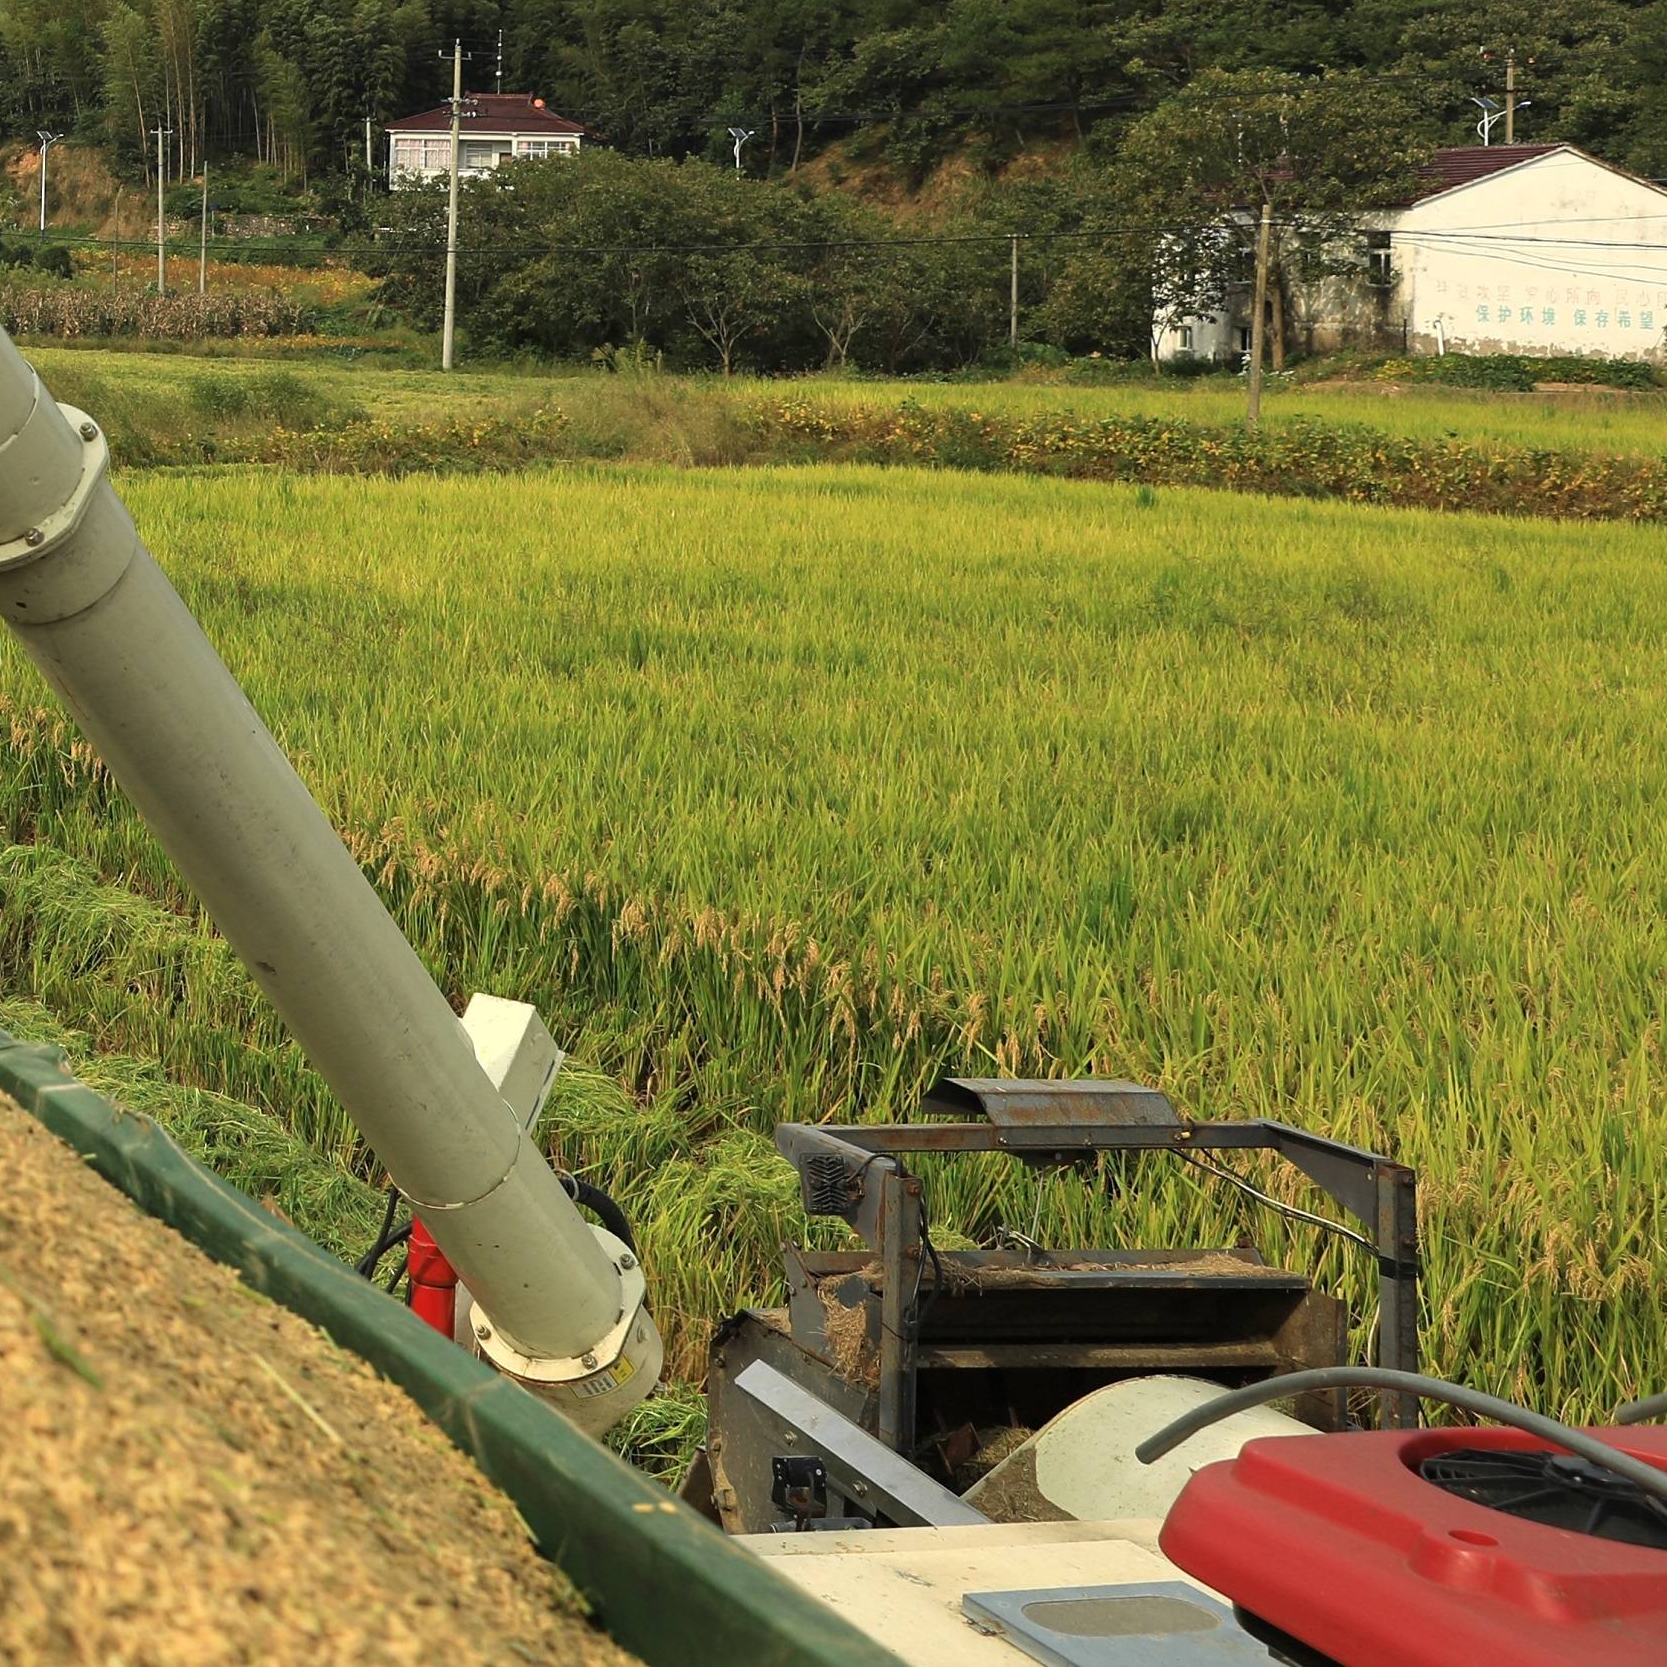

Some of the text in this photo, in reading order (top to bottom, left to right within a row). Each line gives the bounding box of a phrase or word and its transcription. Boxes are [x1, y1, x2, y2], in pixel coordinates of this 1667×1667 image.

[1475, 304, 1655, 330] 保护环境 保存希望
